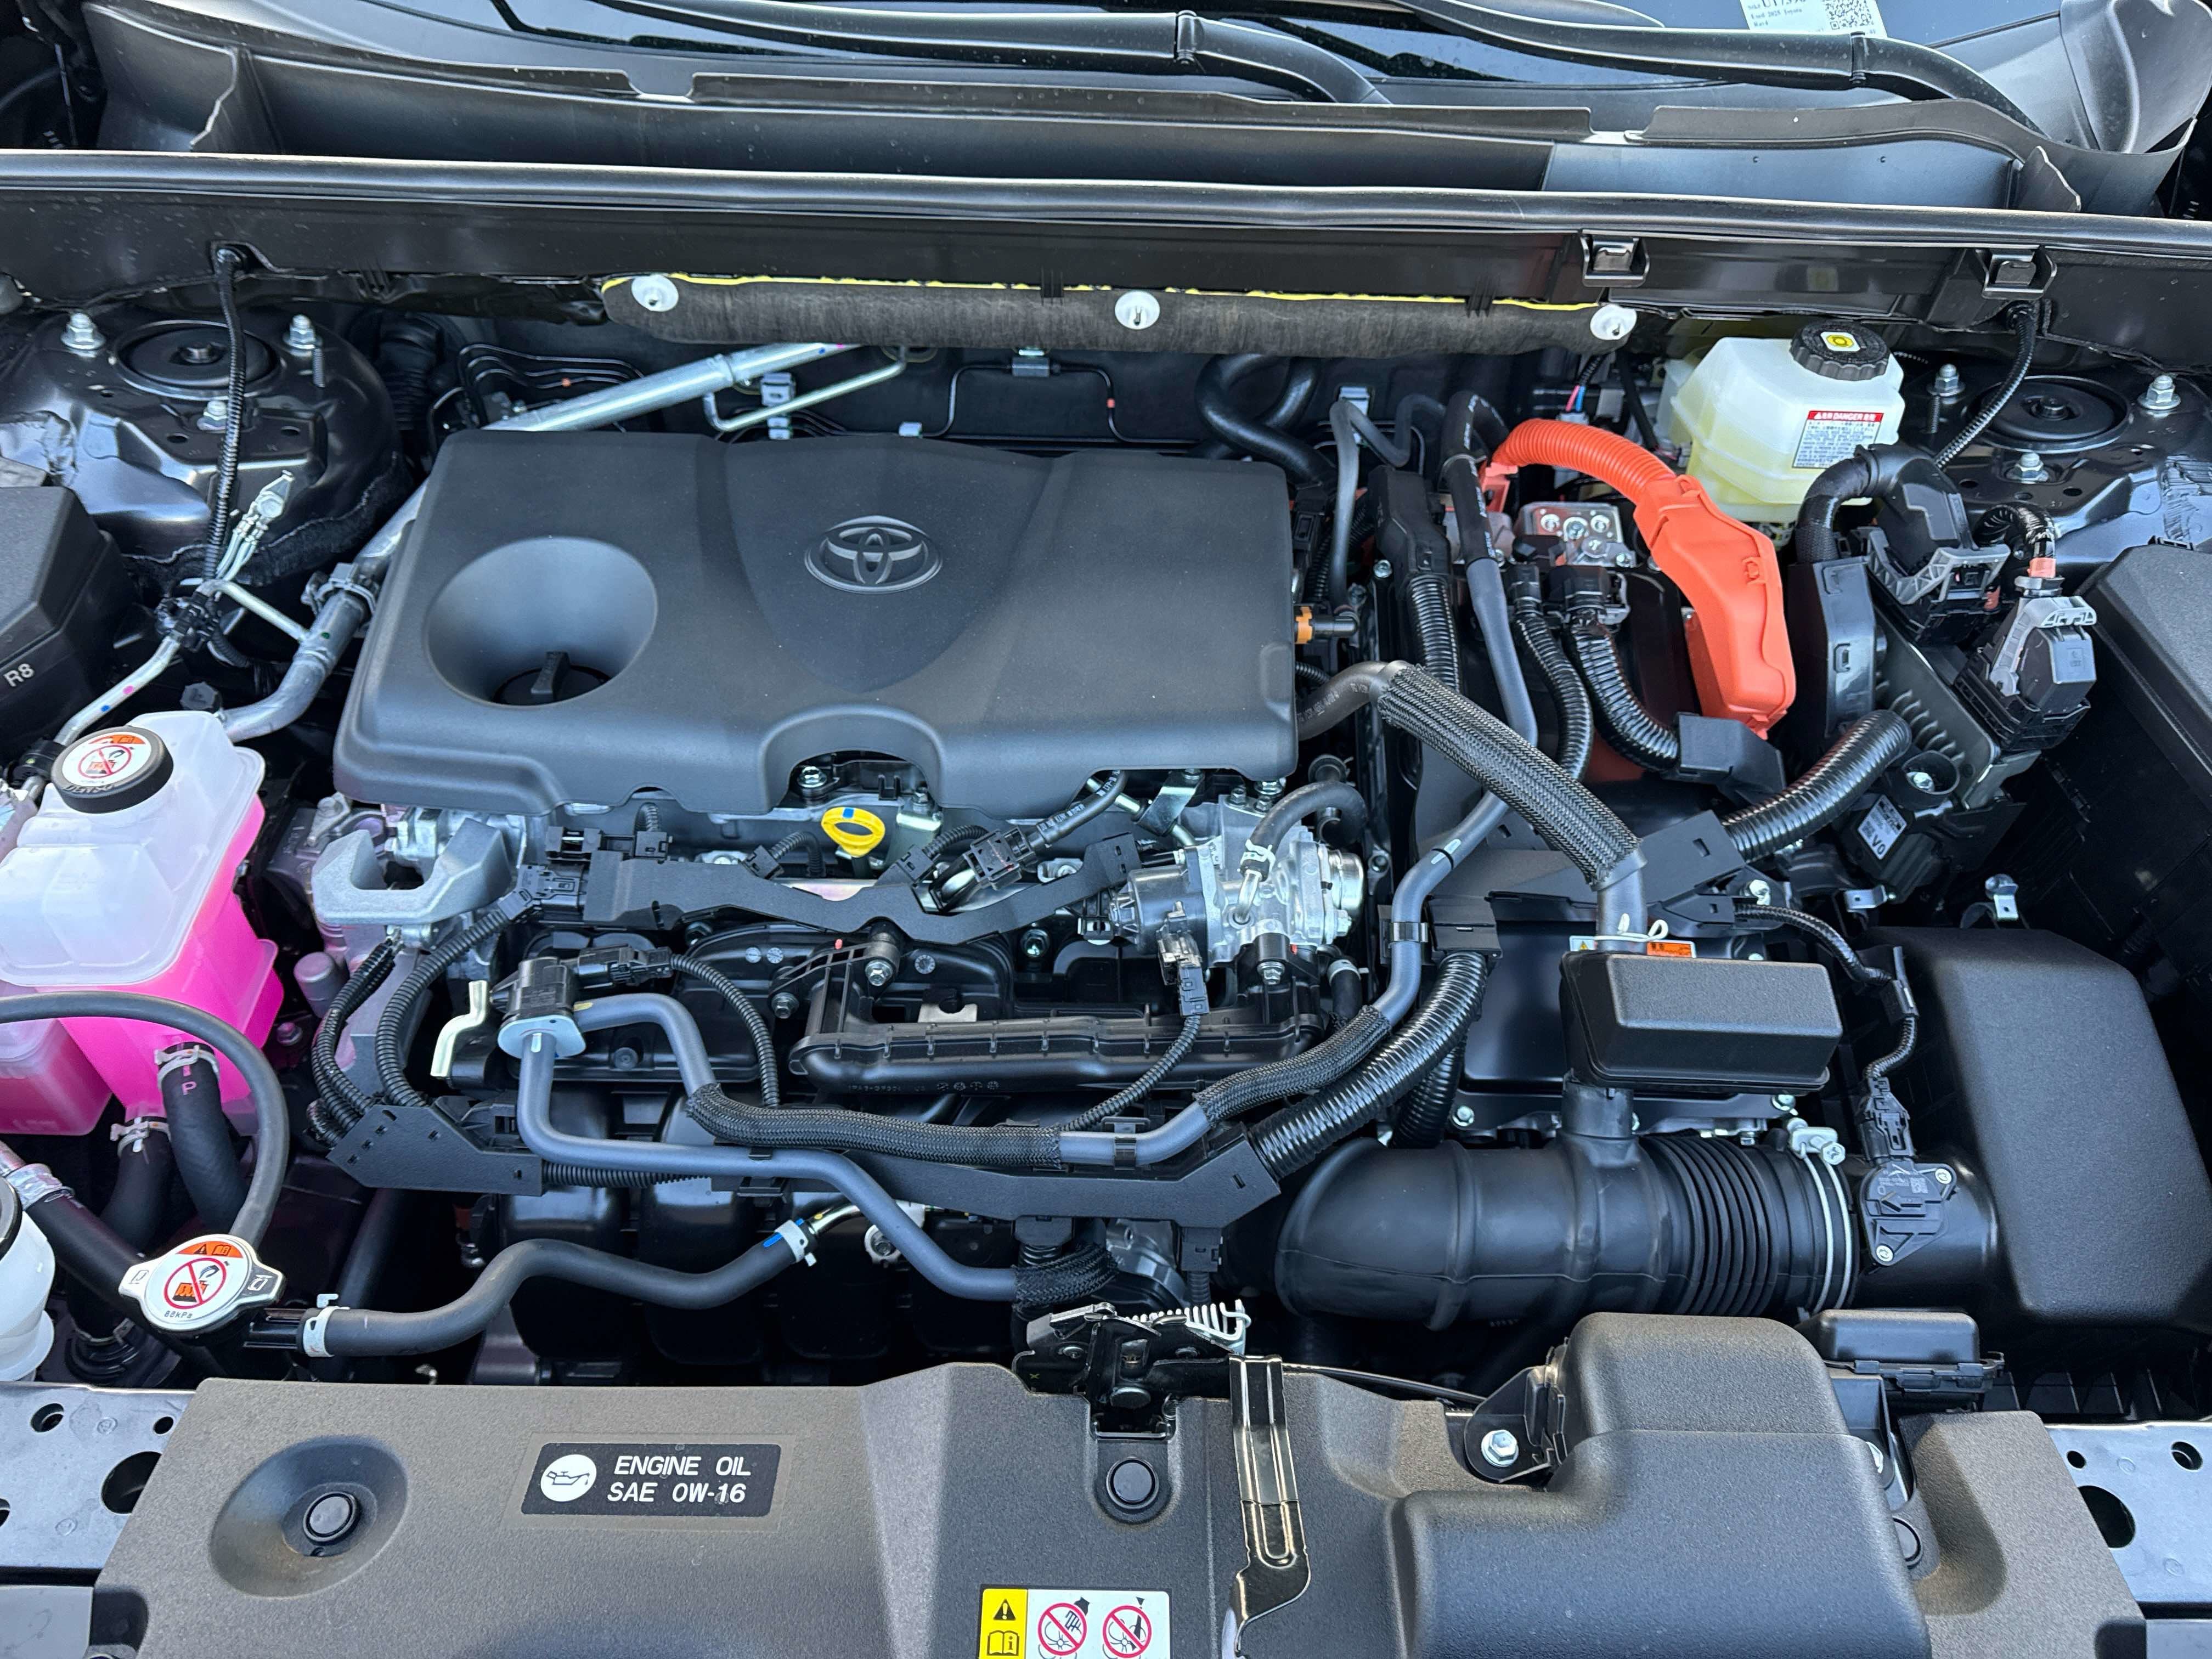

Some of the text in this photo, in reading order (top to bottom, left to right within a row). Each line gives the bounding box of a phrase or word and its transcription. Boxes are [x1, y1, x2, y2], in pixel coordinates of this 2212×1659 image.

[1832, 413, 1863, 421] DANGER
[3, 663, 35, 687] R8
[182, 1081, 196, 1095] P
[165, 1310, 193, 1318] 88kPa
[614, 1455, 751, 1476] ENGINE OIL
[607, 1482, 747, 1503] SAE 0W-16
